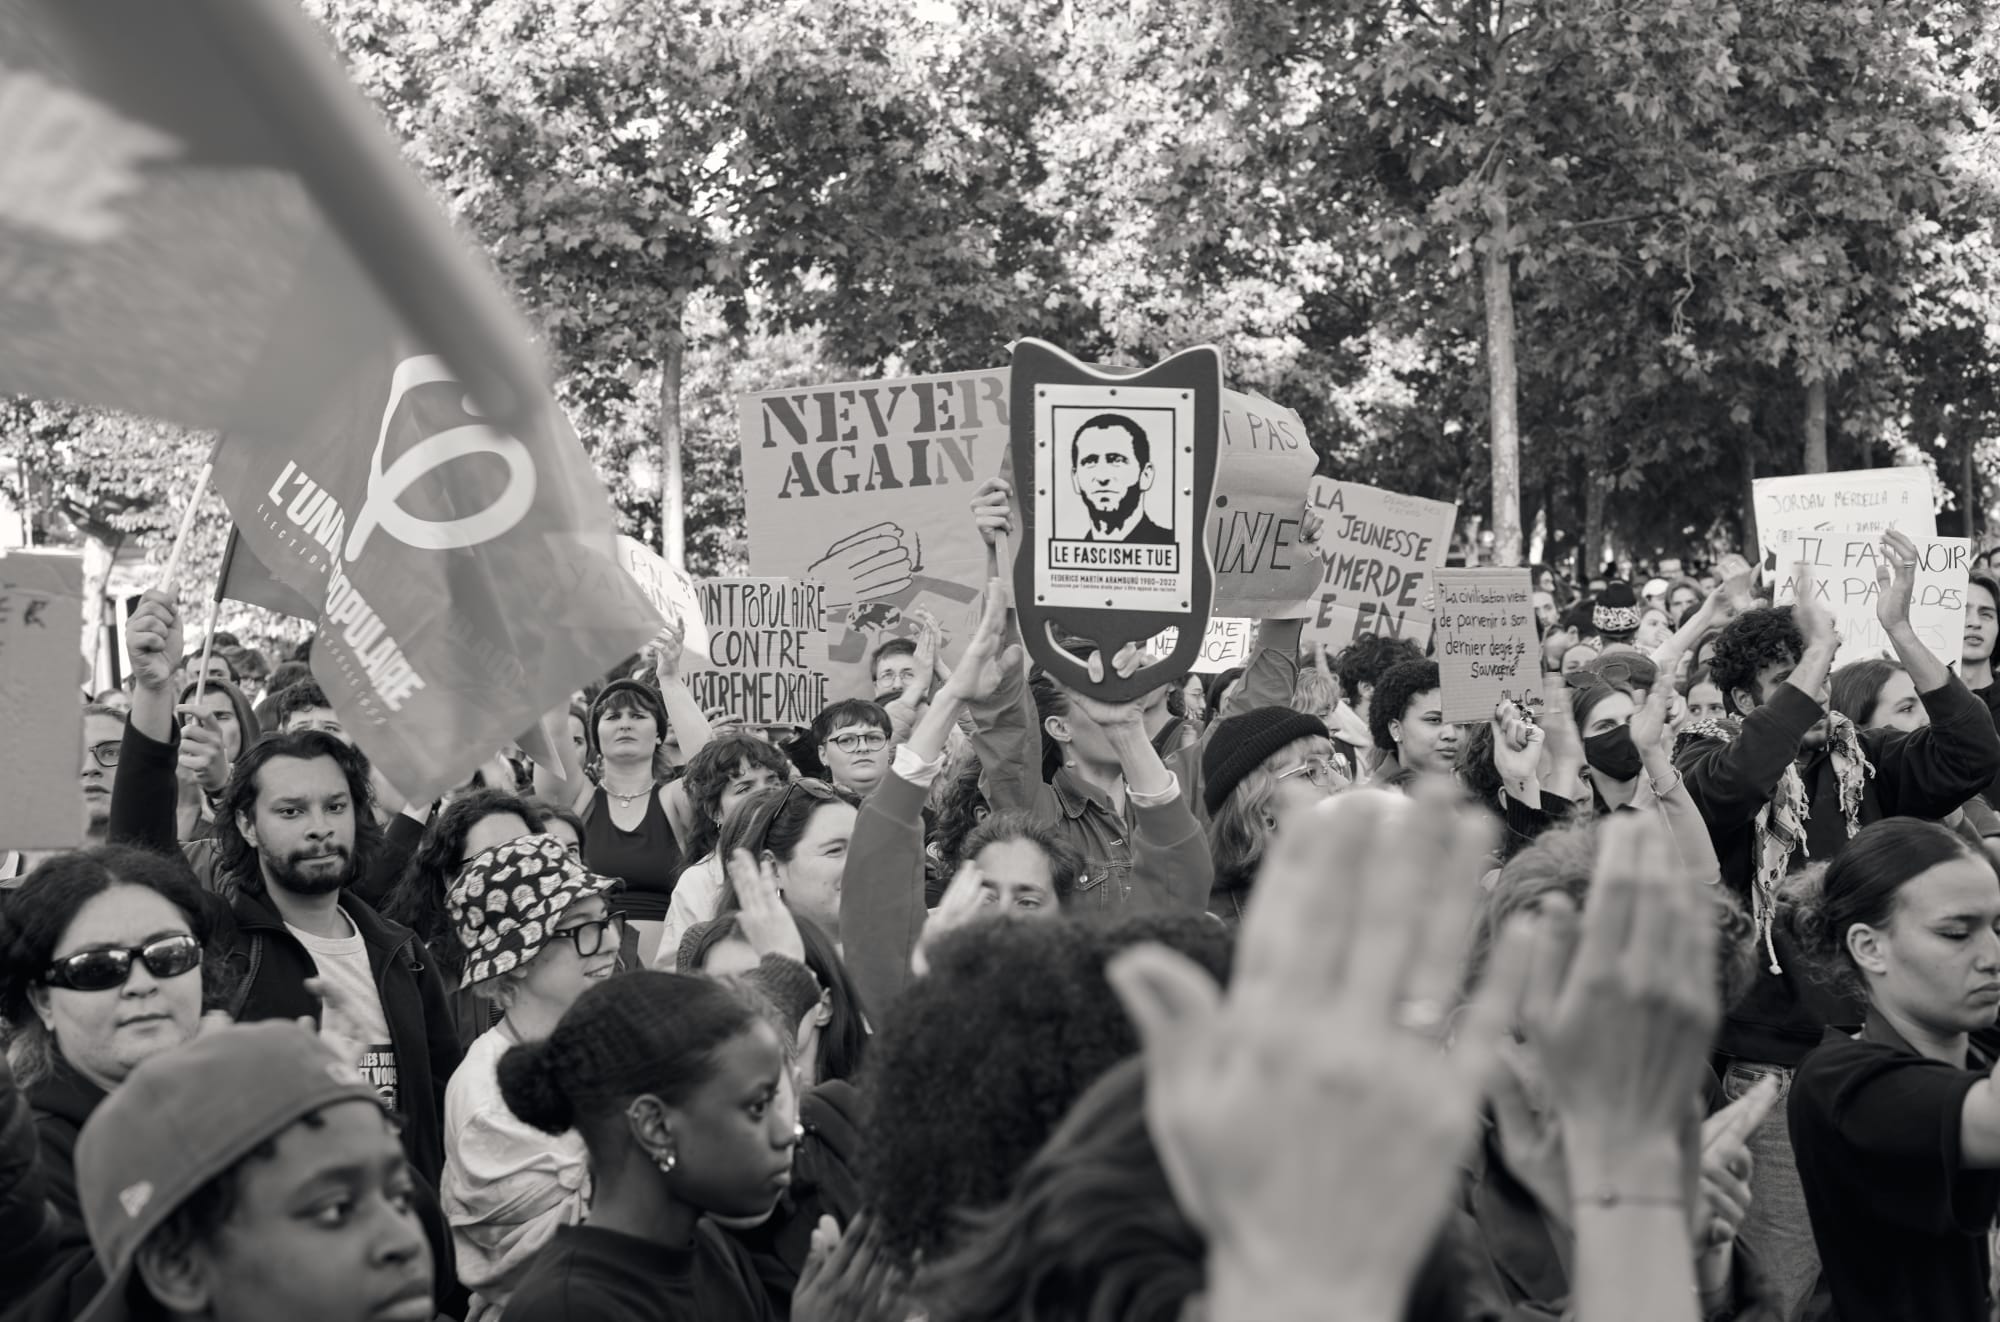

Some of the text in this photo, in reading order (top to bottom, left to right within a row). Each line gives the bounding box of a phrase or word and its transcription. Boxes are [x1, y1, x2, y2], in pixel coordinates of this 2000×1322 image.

[761, 376, 1011, 449] NEVER
[1247, 412, 1299, 452] PAS
[778, 434, 979, 499] AGAIN
[1314, 484, 1345, 513] LA
[1767, 493, 1826, 514] JORDAN
[1901, 490, 1909, 505] A
[1337, 514, 1433, 563] JEUNESSE
[1793, 537, 1832, 568] IL
[1054, 546, 1172, 567] LE FASCISME TUE
[1317, 547, 1424, 608] MMERDE
[1920, 584, 1963, 610] DES
[1440, 607, 1452, 628] de
[1457, 612, 1498, 635] parvenir
[709, 629, 809, 669] CONTRE
[1445, 631, 1487, 656] dernier
